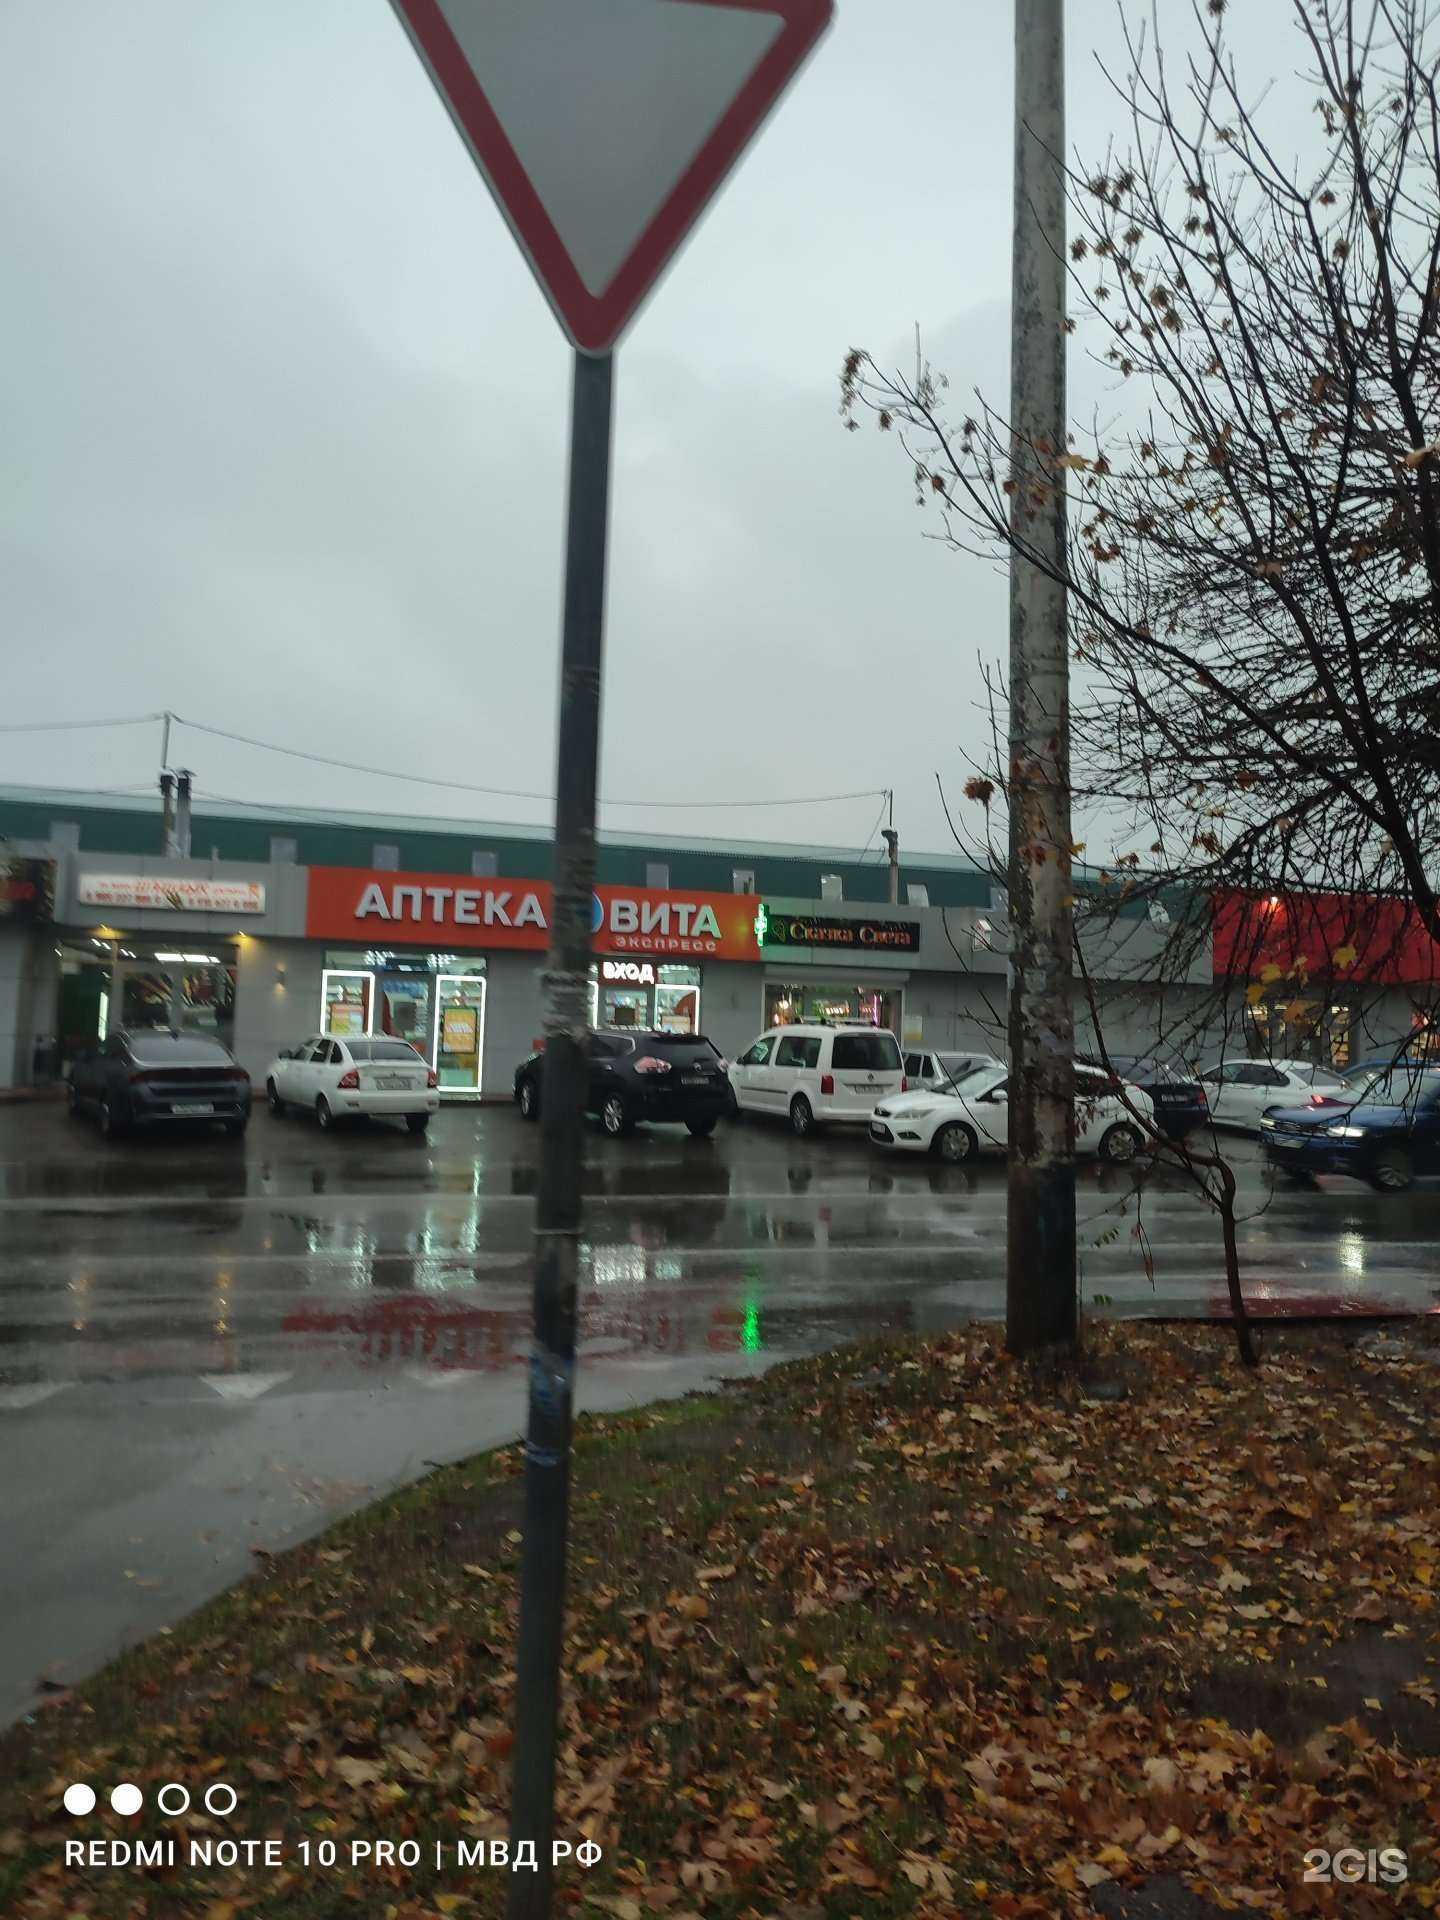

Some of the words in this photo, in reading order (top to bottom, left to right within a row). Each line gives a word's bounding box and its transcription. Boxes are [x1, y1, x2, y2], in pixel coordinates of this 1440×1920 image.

[355, 883, 548, 929] АПТЕКА
[609, 899, 722, 939] ВИТА
[615, 935, 717, 953] ЭКСПРЕСС
[602, 961, 655, 985] ВХОД
